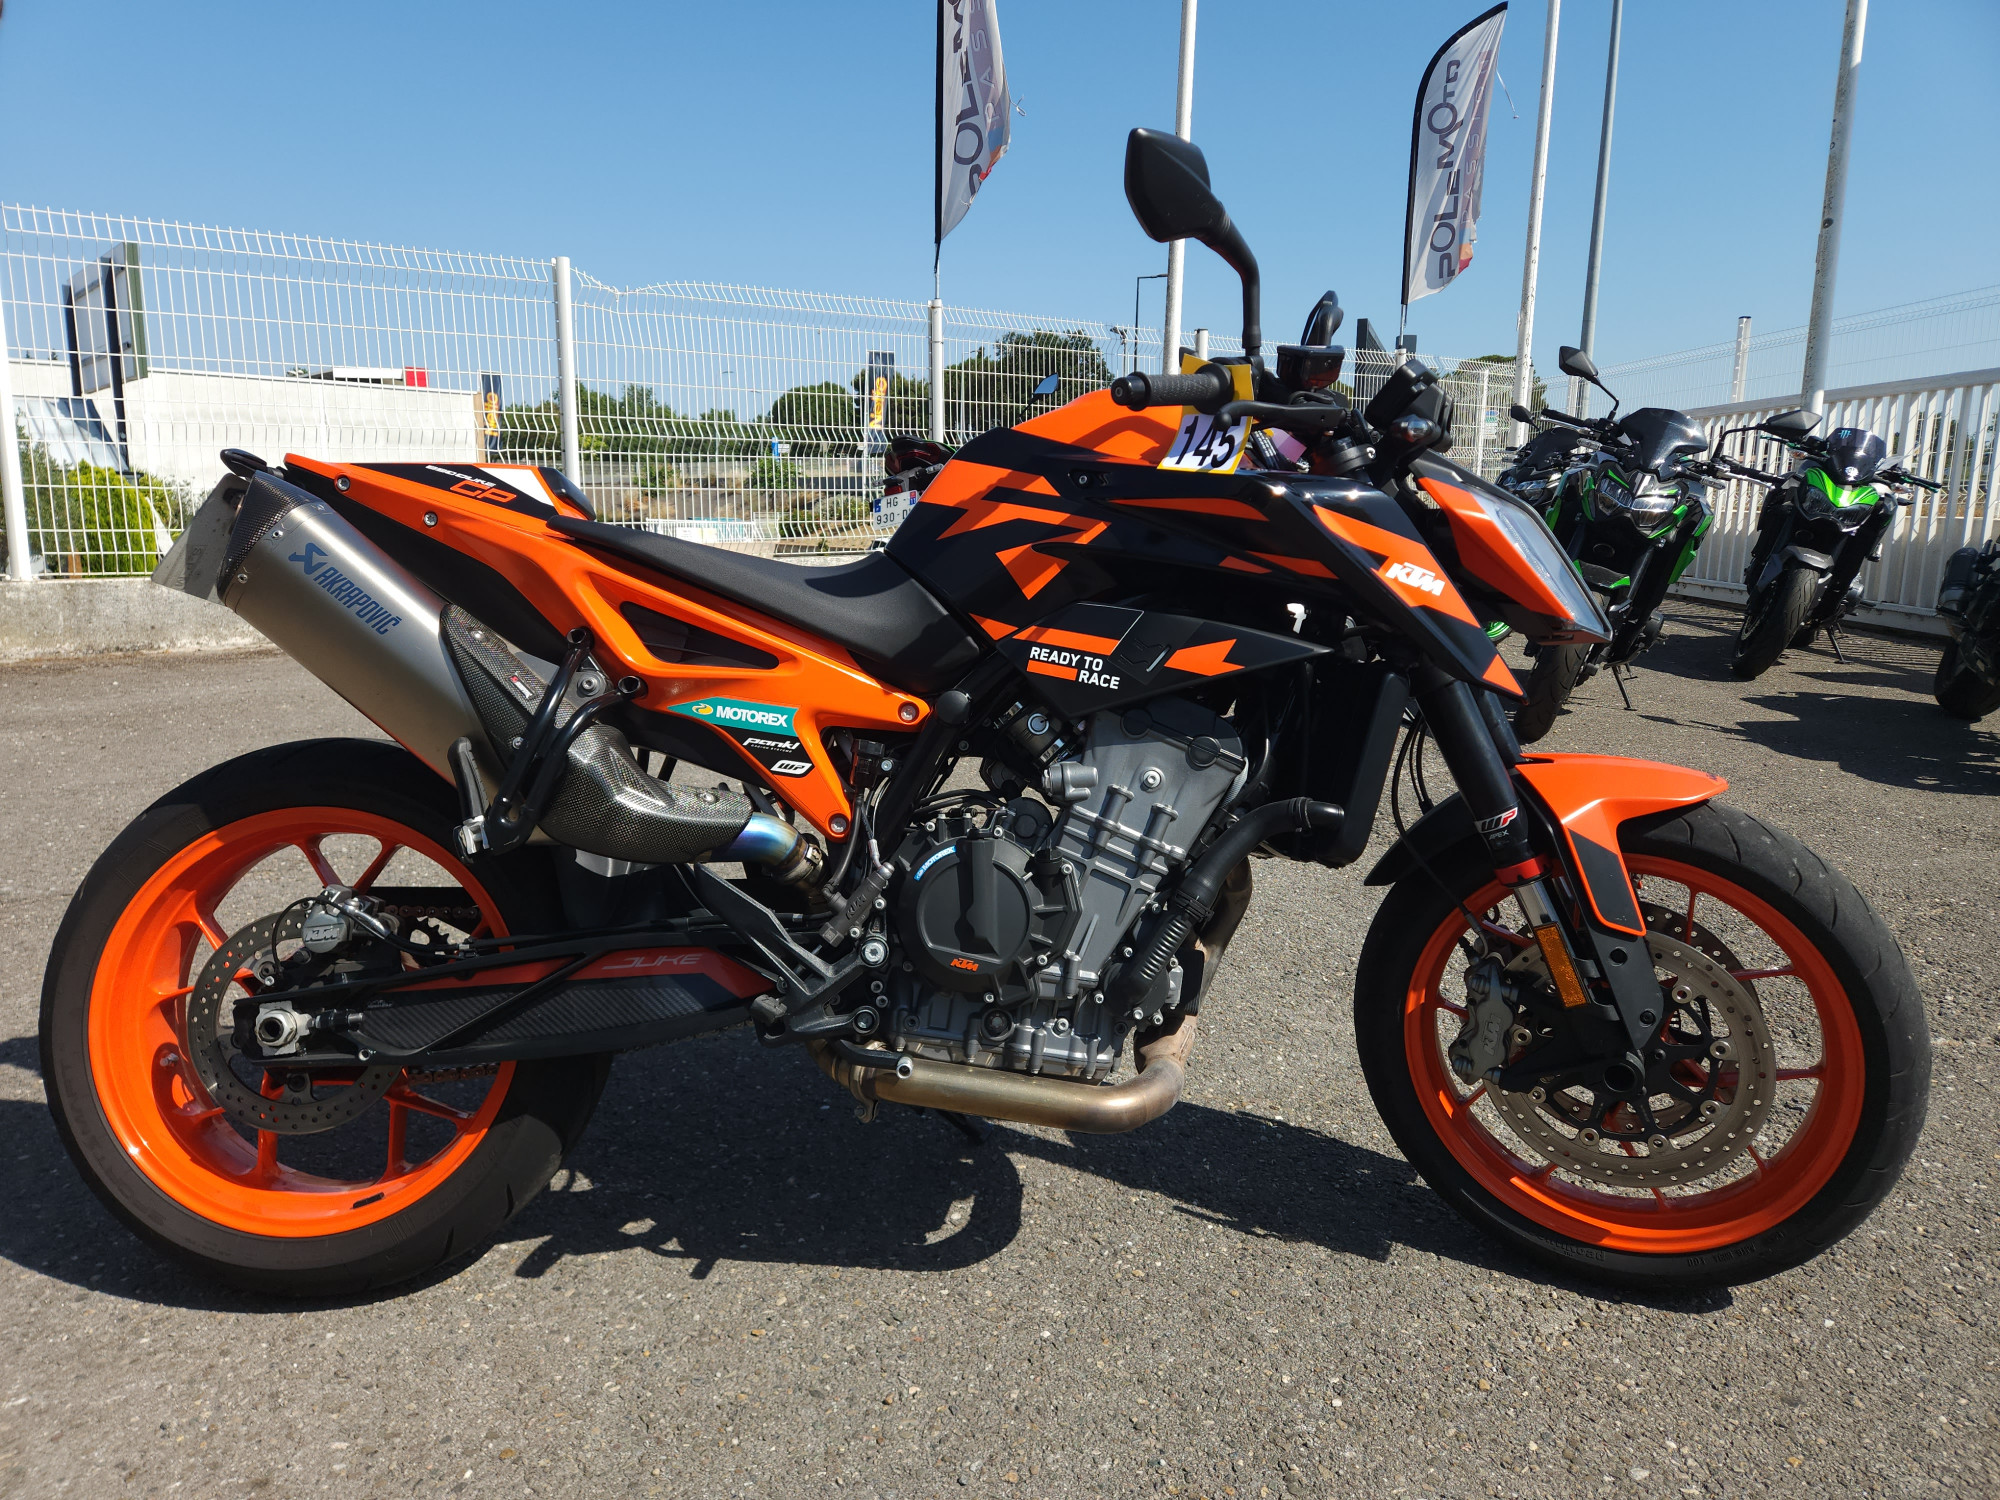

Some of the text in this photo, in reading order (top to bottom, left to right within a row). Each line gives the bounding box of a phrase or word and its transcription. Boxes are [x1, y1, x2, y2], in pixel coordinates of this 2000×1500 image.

[1429, 168, 1461, 281] POLE
[1175, 415, 1236, 468] 145
[449, 479, 517, 503] GP
[876, 508, 911, 525] 930-D
[1385, 561, 1446, 597] KTM
[1030, 646, 1104, 671] READY TO
[1078, 669, 1121, 690] RACE
[716, 705, 788, 727] MOTOREX
[1480, 807, 1518, 833] WP
[305, 926, 340, 943] KTM
[602, 953, 703, 970] DUKE
[950, 957, 979, 972] KTM
